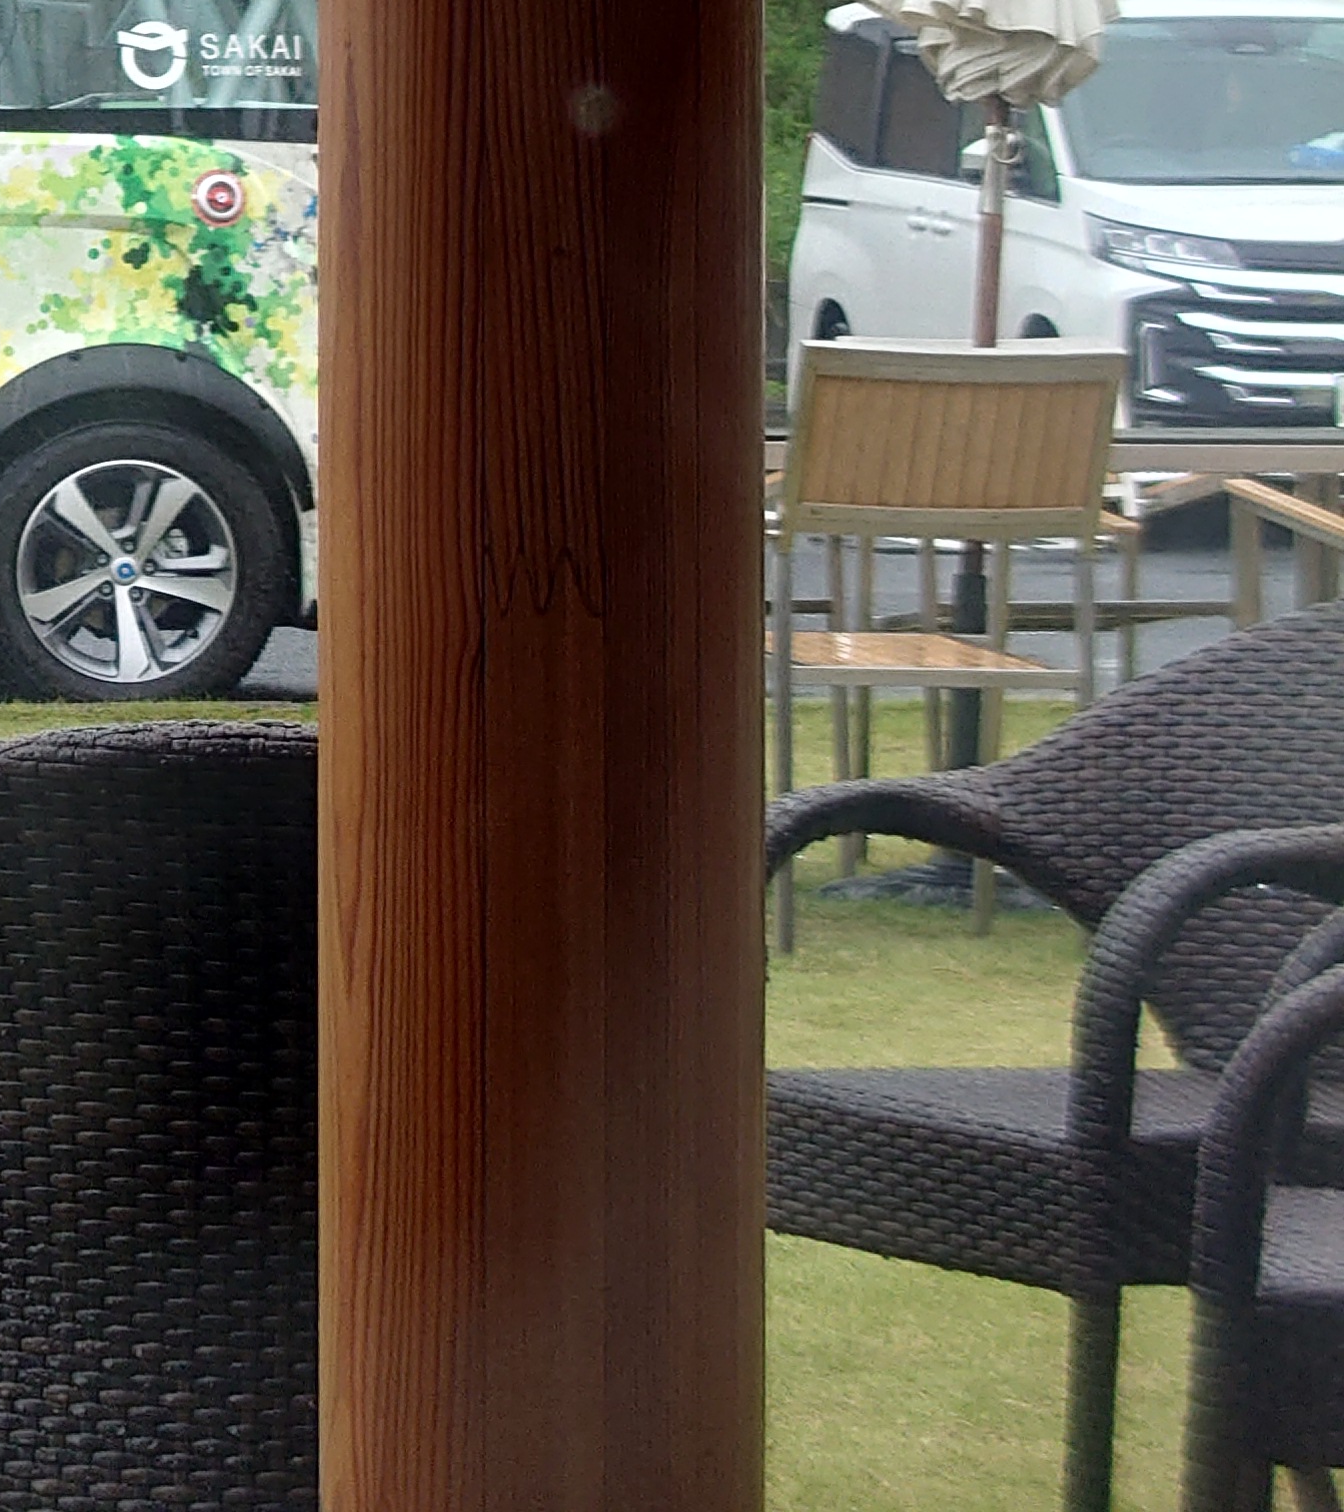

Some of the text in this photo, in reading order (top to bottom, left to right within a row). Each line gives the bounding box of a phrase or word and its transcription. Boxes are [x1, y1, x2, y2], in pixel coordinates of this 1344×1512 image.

[199, 33, 302, 60] SAKAI
[202, 65, 242, 77] TOWN
[265, 65, 302, 77] SAKAI
